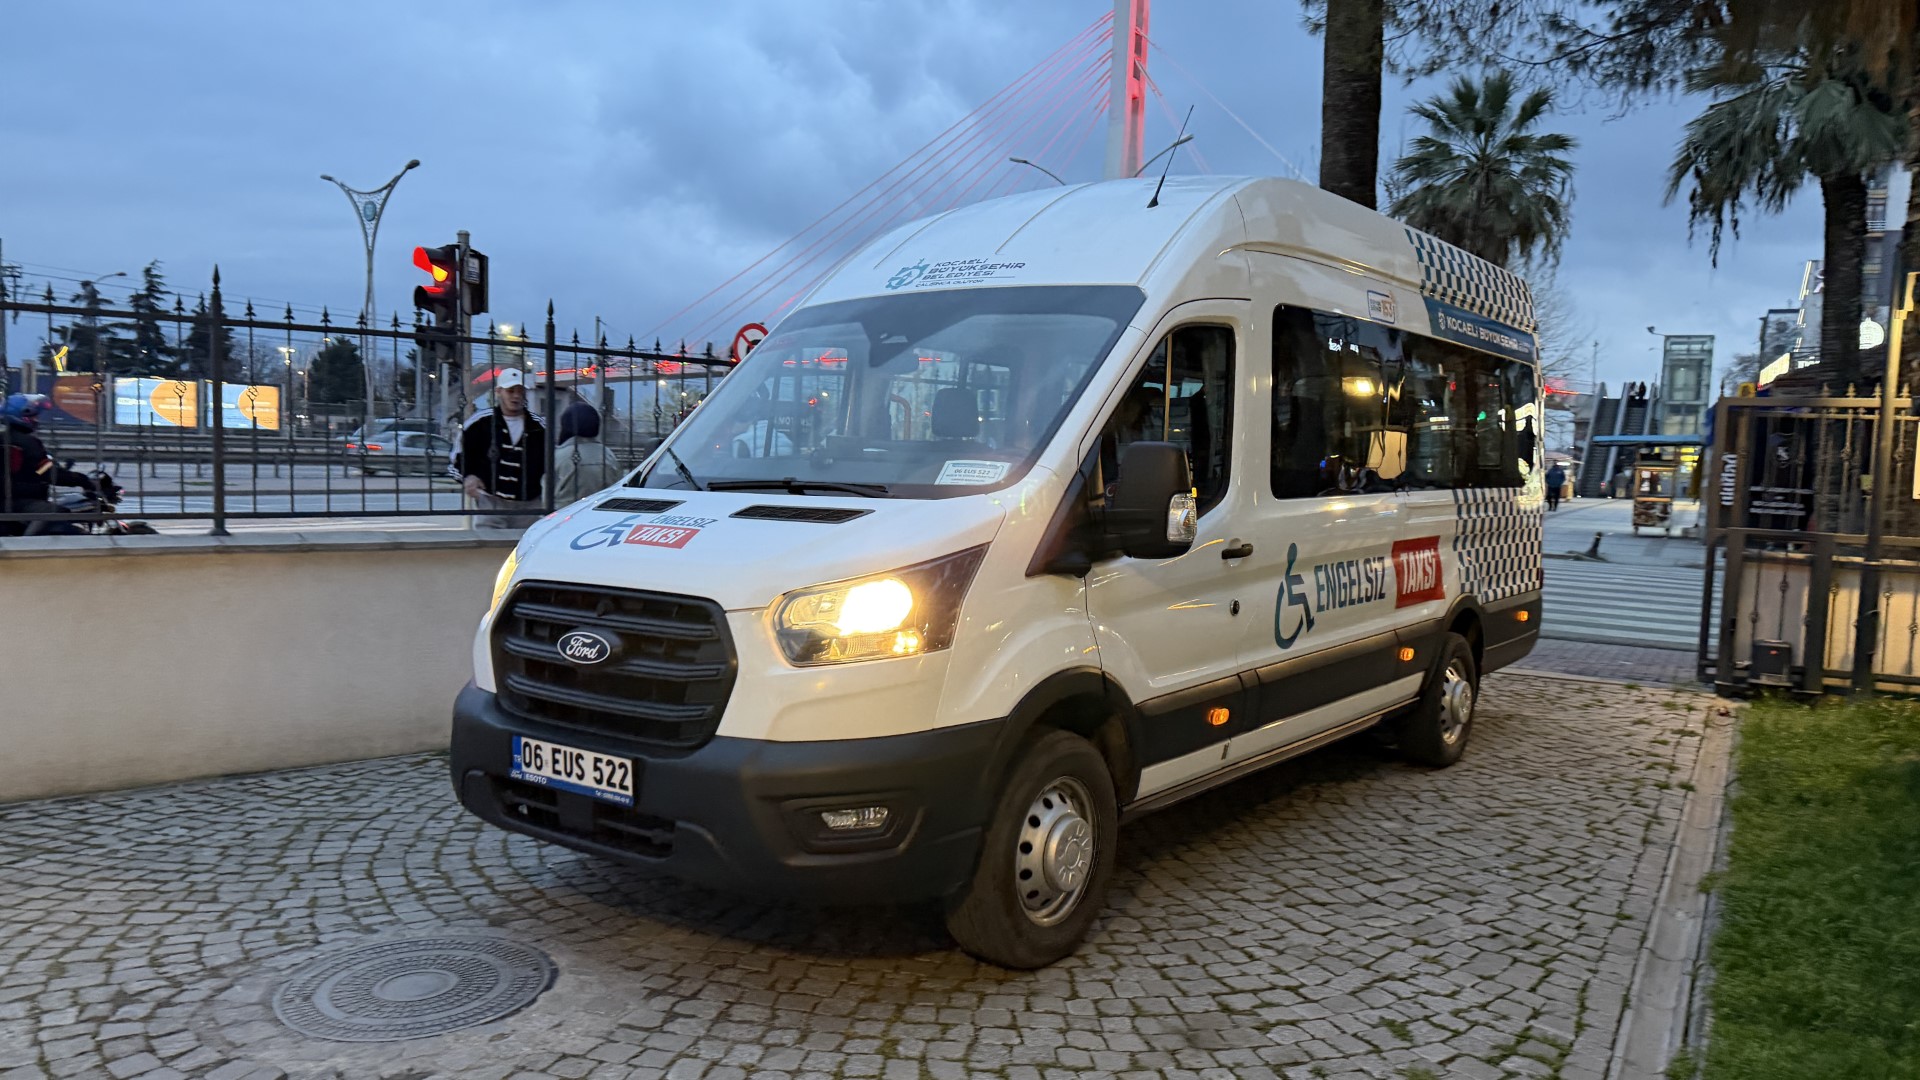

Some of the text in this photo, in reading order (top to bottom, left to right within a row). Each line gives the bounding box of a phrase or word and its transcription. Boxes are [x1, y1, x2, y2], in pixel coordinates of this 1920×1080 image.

[629, 527, 690, 544] TAKSİ
[1314, 556, 1386, 612] ENGELSİZ
[1400, 548, 1435, 594] TAKSİ
[566, 636, 600, 659] Ford
[523, 741, 629, 791] 06 EUS 522
